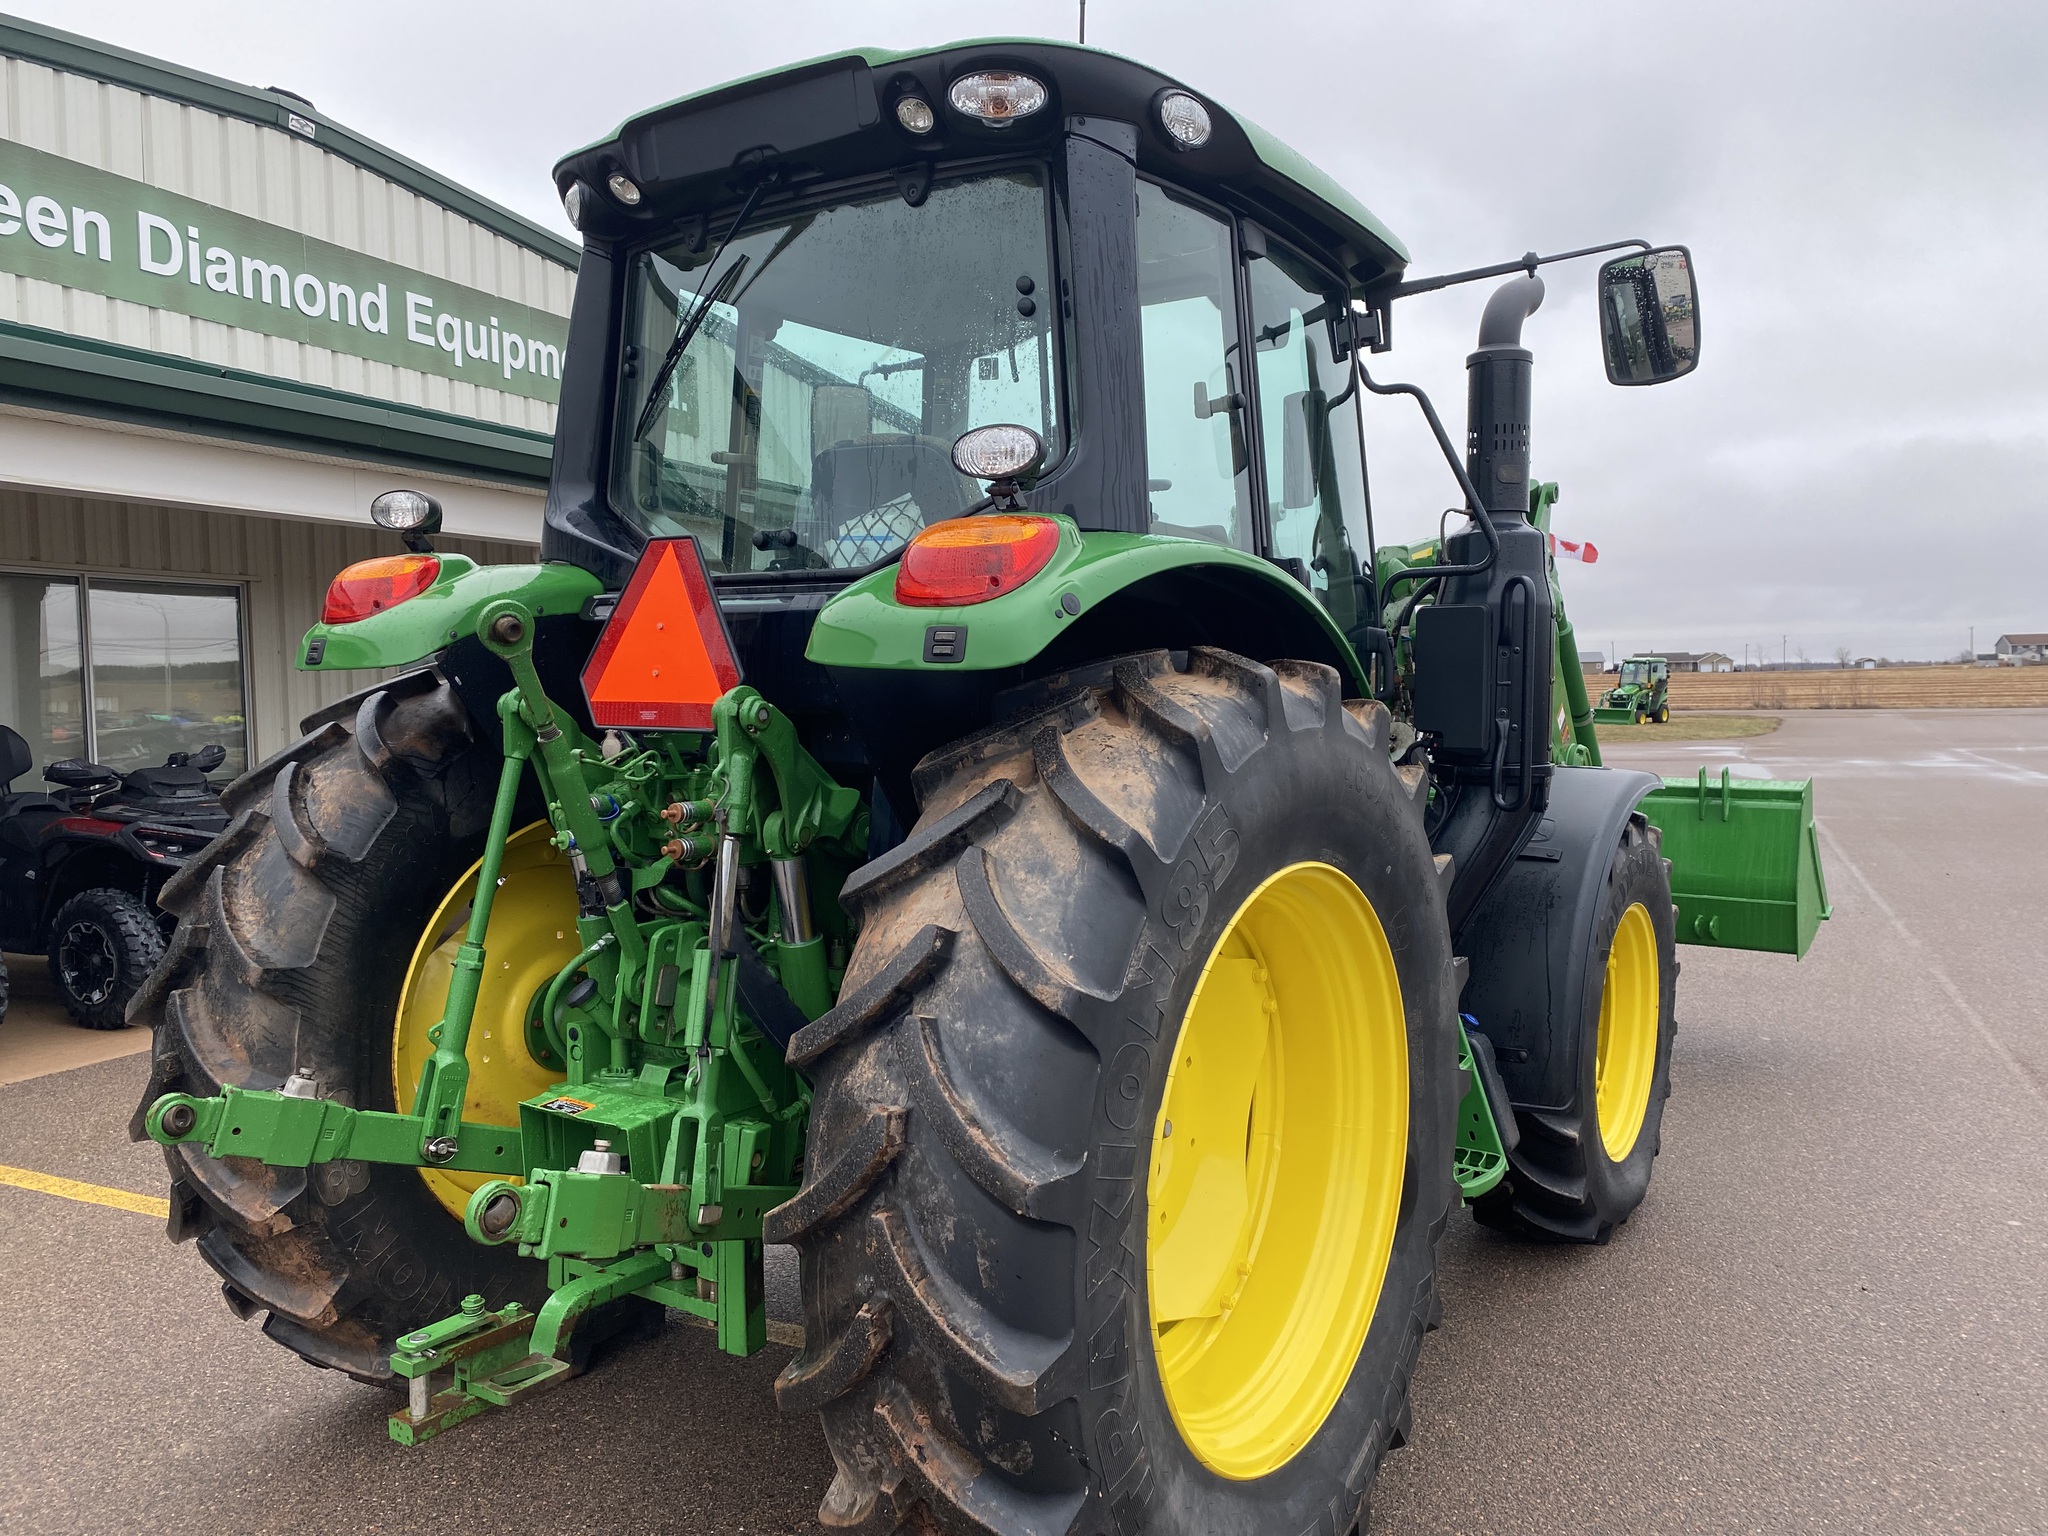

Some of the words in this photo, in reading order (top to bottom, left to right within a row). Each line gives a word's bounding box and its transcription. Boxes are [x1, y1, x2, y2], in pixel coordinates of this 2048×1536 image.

[138, 210, 389, 335] Diamond
[406, 290, 566, 380] Equipm
[1161, 801, 1241, 951] 85
